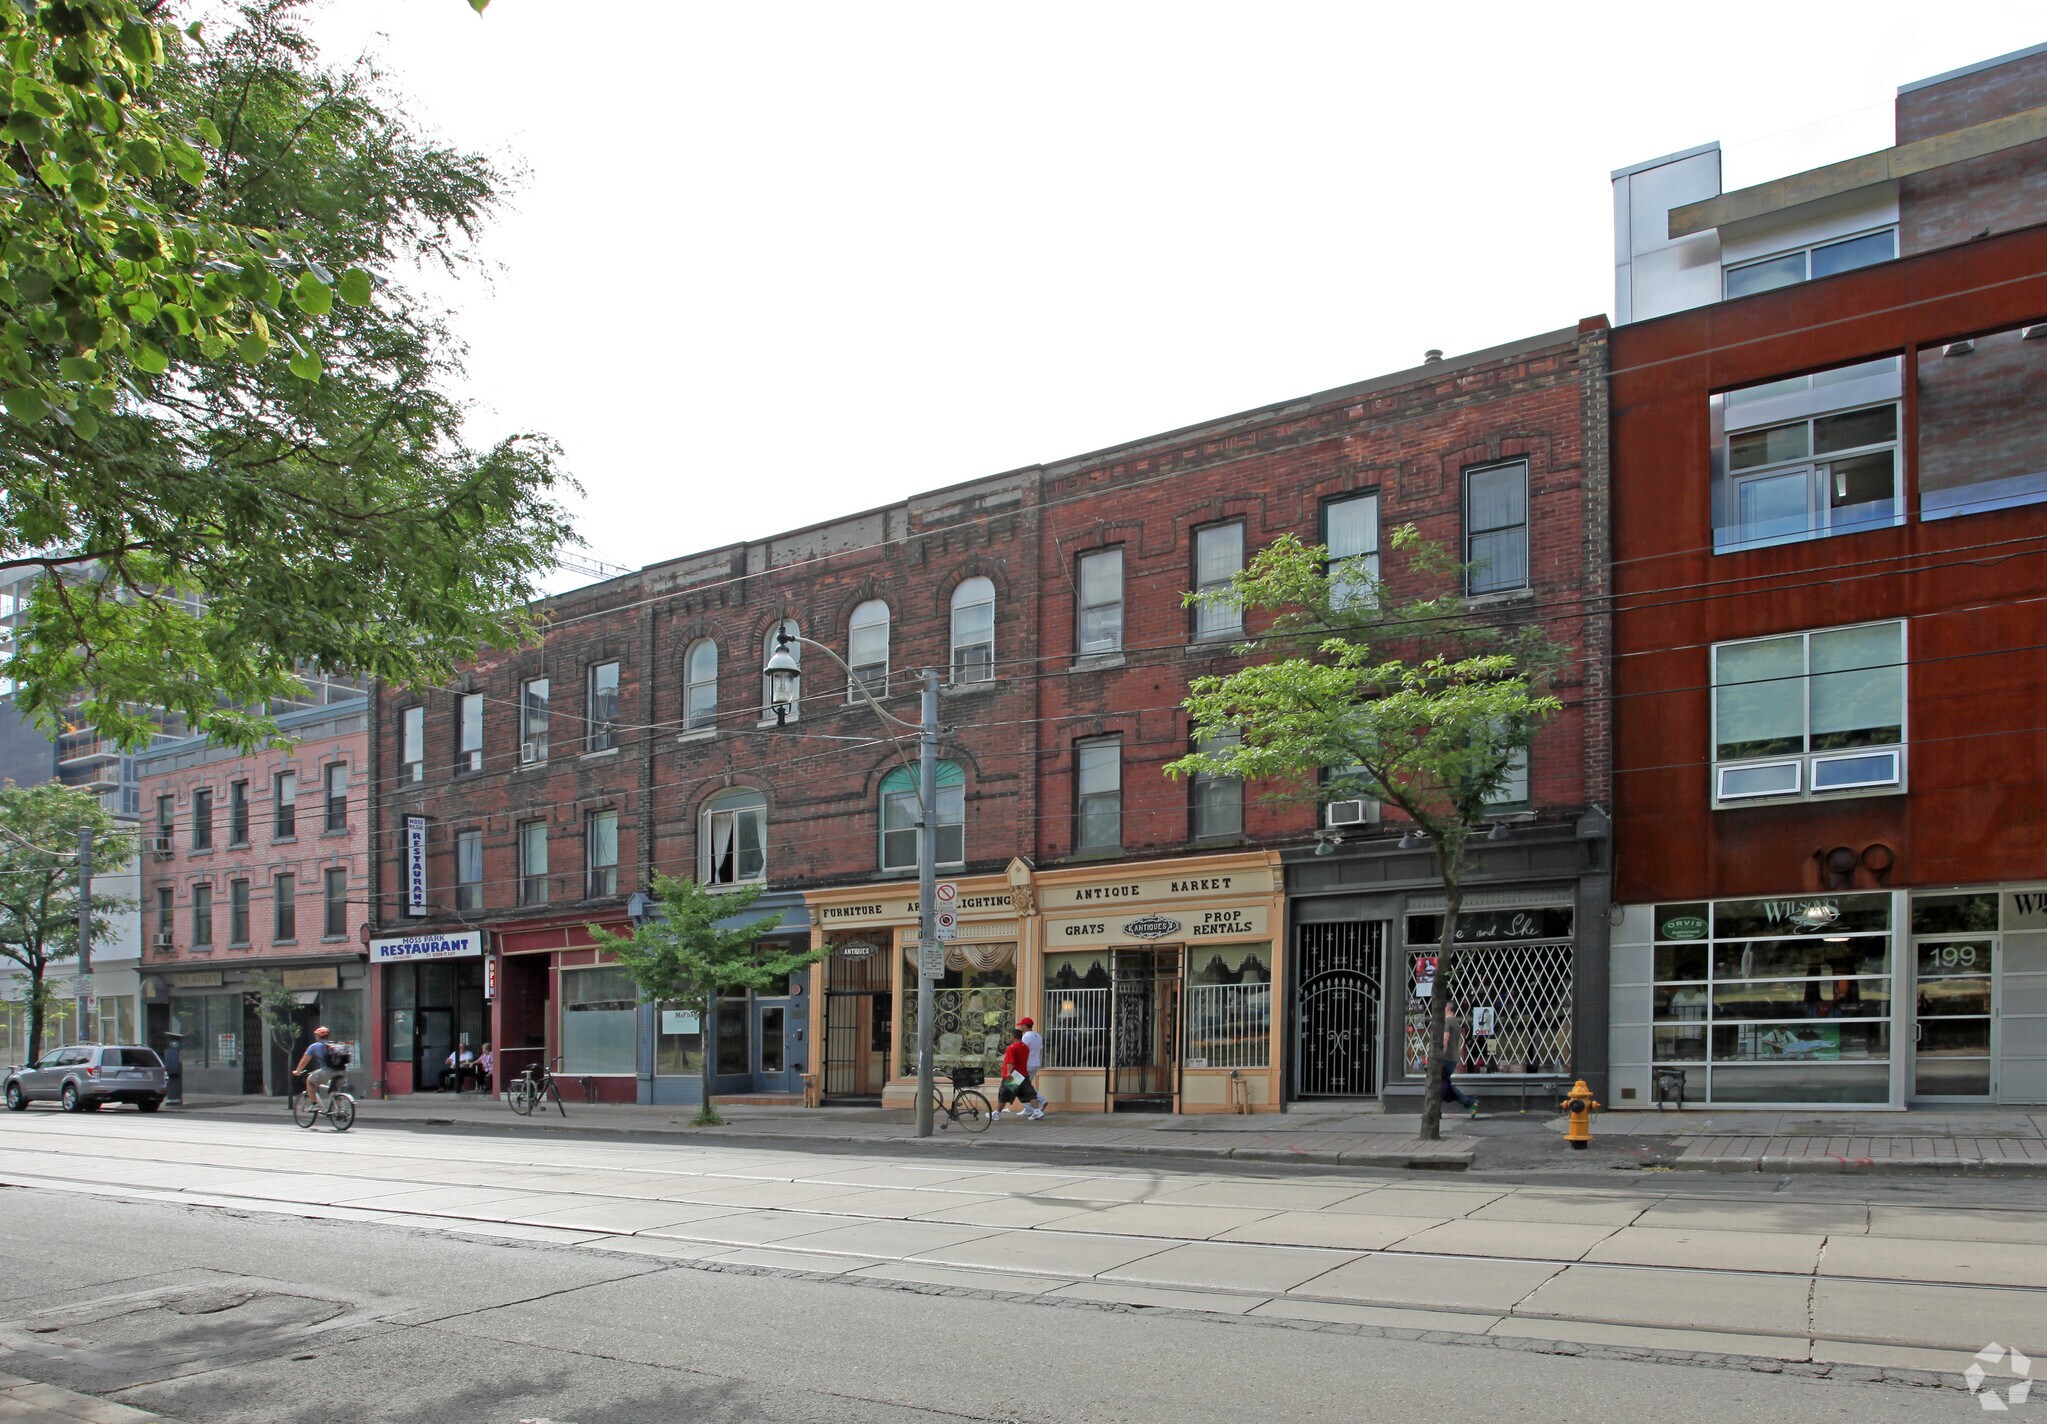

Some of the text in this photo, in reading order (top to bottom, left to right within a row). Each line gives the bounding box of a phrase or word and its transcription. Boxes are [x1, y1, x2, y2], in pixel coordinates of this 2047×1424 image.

[412, 832, 422, 907] RESTAURANT
[1075, 878, 1231, 900] ANTIQUE MARKET
[1764, 898, 1839, 923] WILSON'S
[2013, 893, 2047, 915] WI
[823, 905, 882, 918] FURNITURE
[1204, 911, 1241, 923] PROP
[1065, 924, 1105, 936] GRAYS
[1134, 923, 1168, 932] ANTIQUES
[1193, 922, 1252, 935] RENTALS
[1476, 925, 1496, 937] and
[1503, 913, 1538, 936] She
[1667, 920, 1702, 928] ORVIS
[402, 934, 445, 944] MOSS PARK
[381, 939, 468, 956] RESTAURANT
[843, 947, 870, 955] ANTIQUES
[1930, 946, 1976, 967] 199
